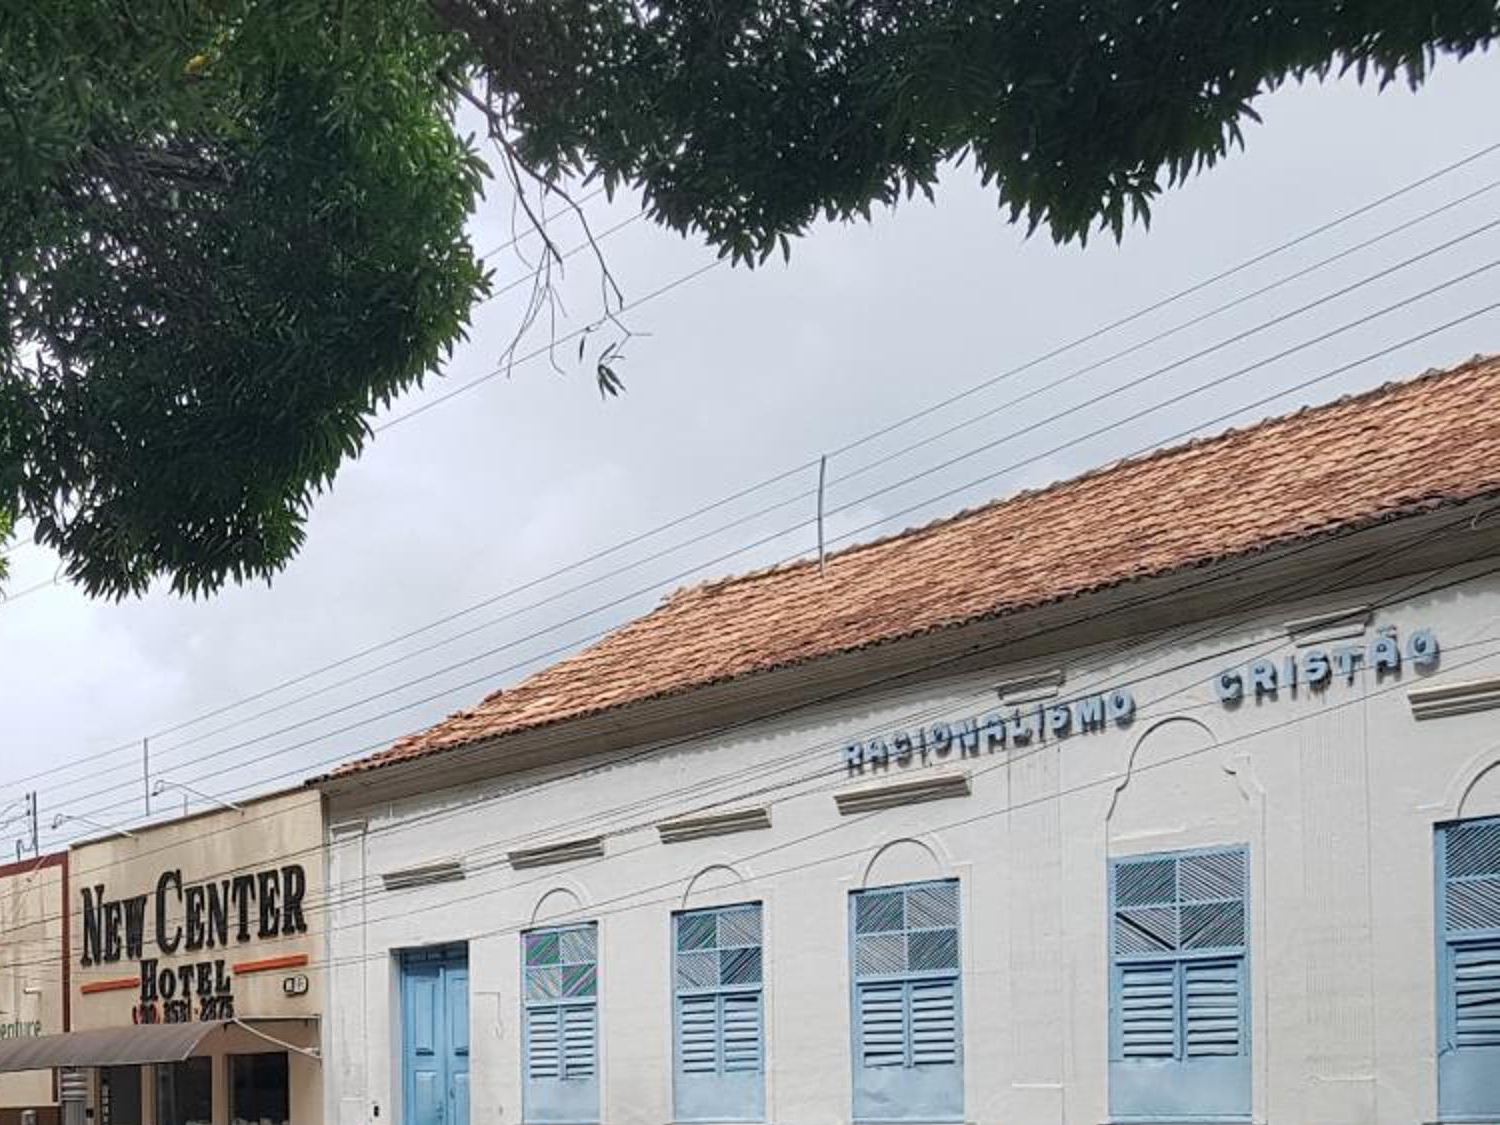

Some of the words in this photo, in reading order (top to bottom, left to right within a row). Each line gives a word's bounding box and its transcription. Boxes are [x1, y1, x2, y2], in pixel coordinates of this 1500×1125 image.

[1215, 624, 1439, 702] CRISTÃO
[80, 884, 147, 967] NEW
[155, 863, 307, 954] CENTER
[140, 958, 231, 1001] HOTEL
